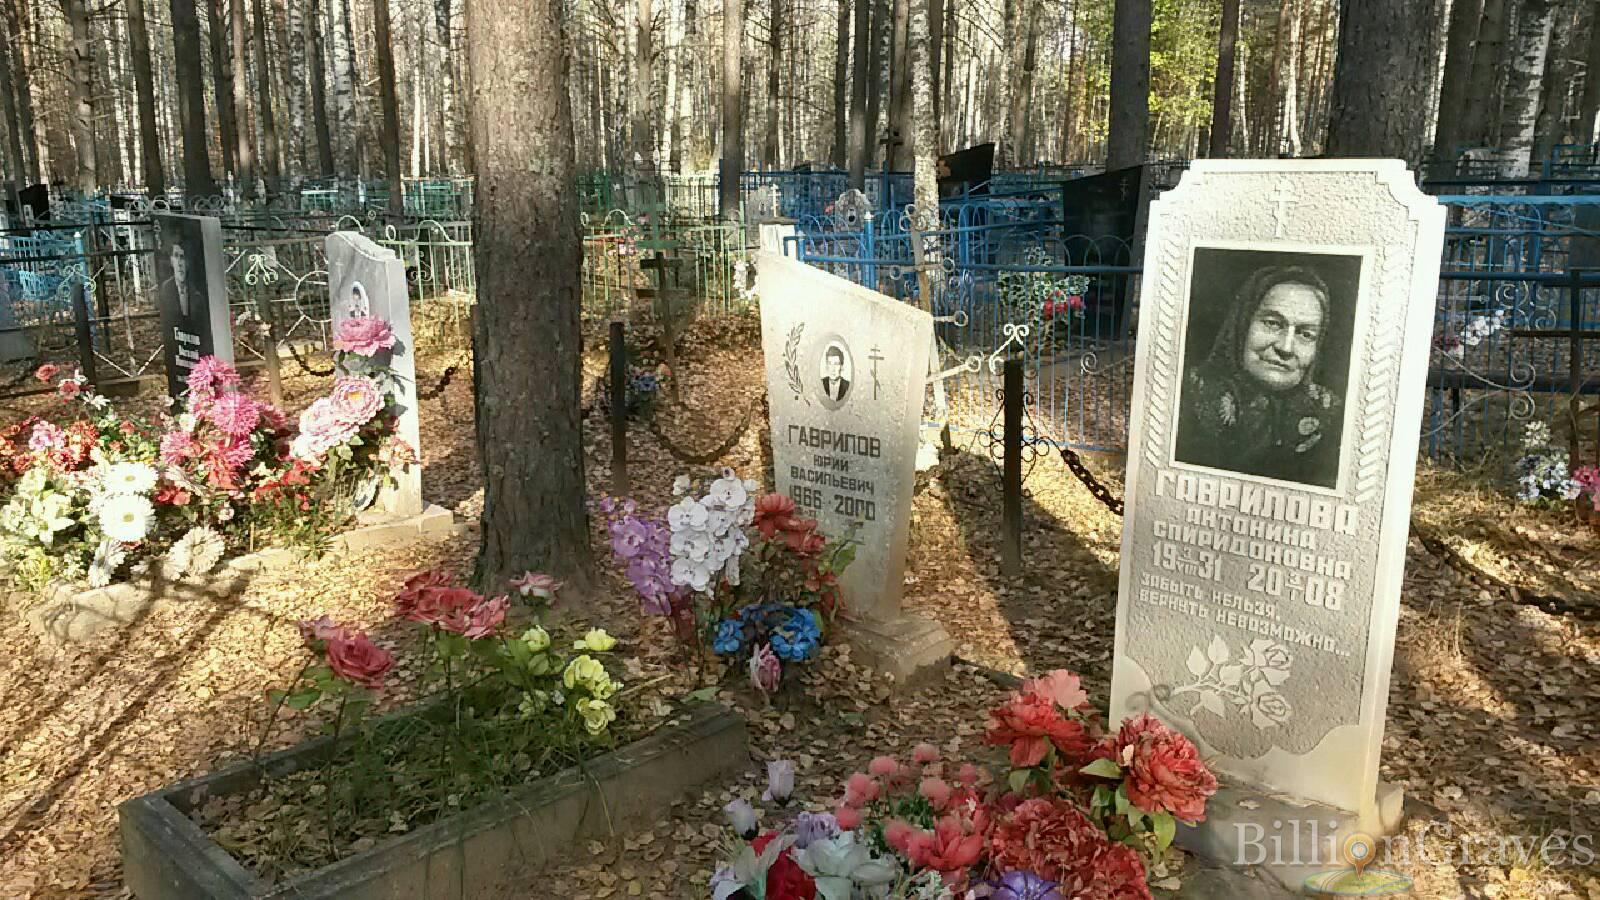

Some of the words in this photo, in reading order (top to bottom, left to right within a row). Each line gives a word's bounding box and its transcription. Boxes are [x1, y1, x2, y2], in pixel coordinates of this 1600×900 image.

[788, 424, 881, 458] ГАВРИЛОВ
[790, 465, 875, 495] ВАСИЛЬЕВИЧ
[1155, 468, 1359, 536] ГАВРИЛОВА
[1186, 507, 1317, 550] АНТОНИНА
[1153, 520, 1352, 581] СПИРИДОНОВНА
[1140, 571, 1202, 600] ЗАБЫТЬ
[1139, 588, 1208, 618] ВЕРНУТЬ
